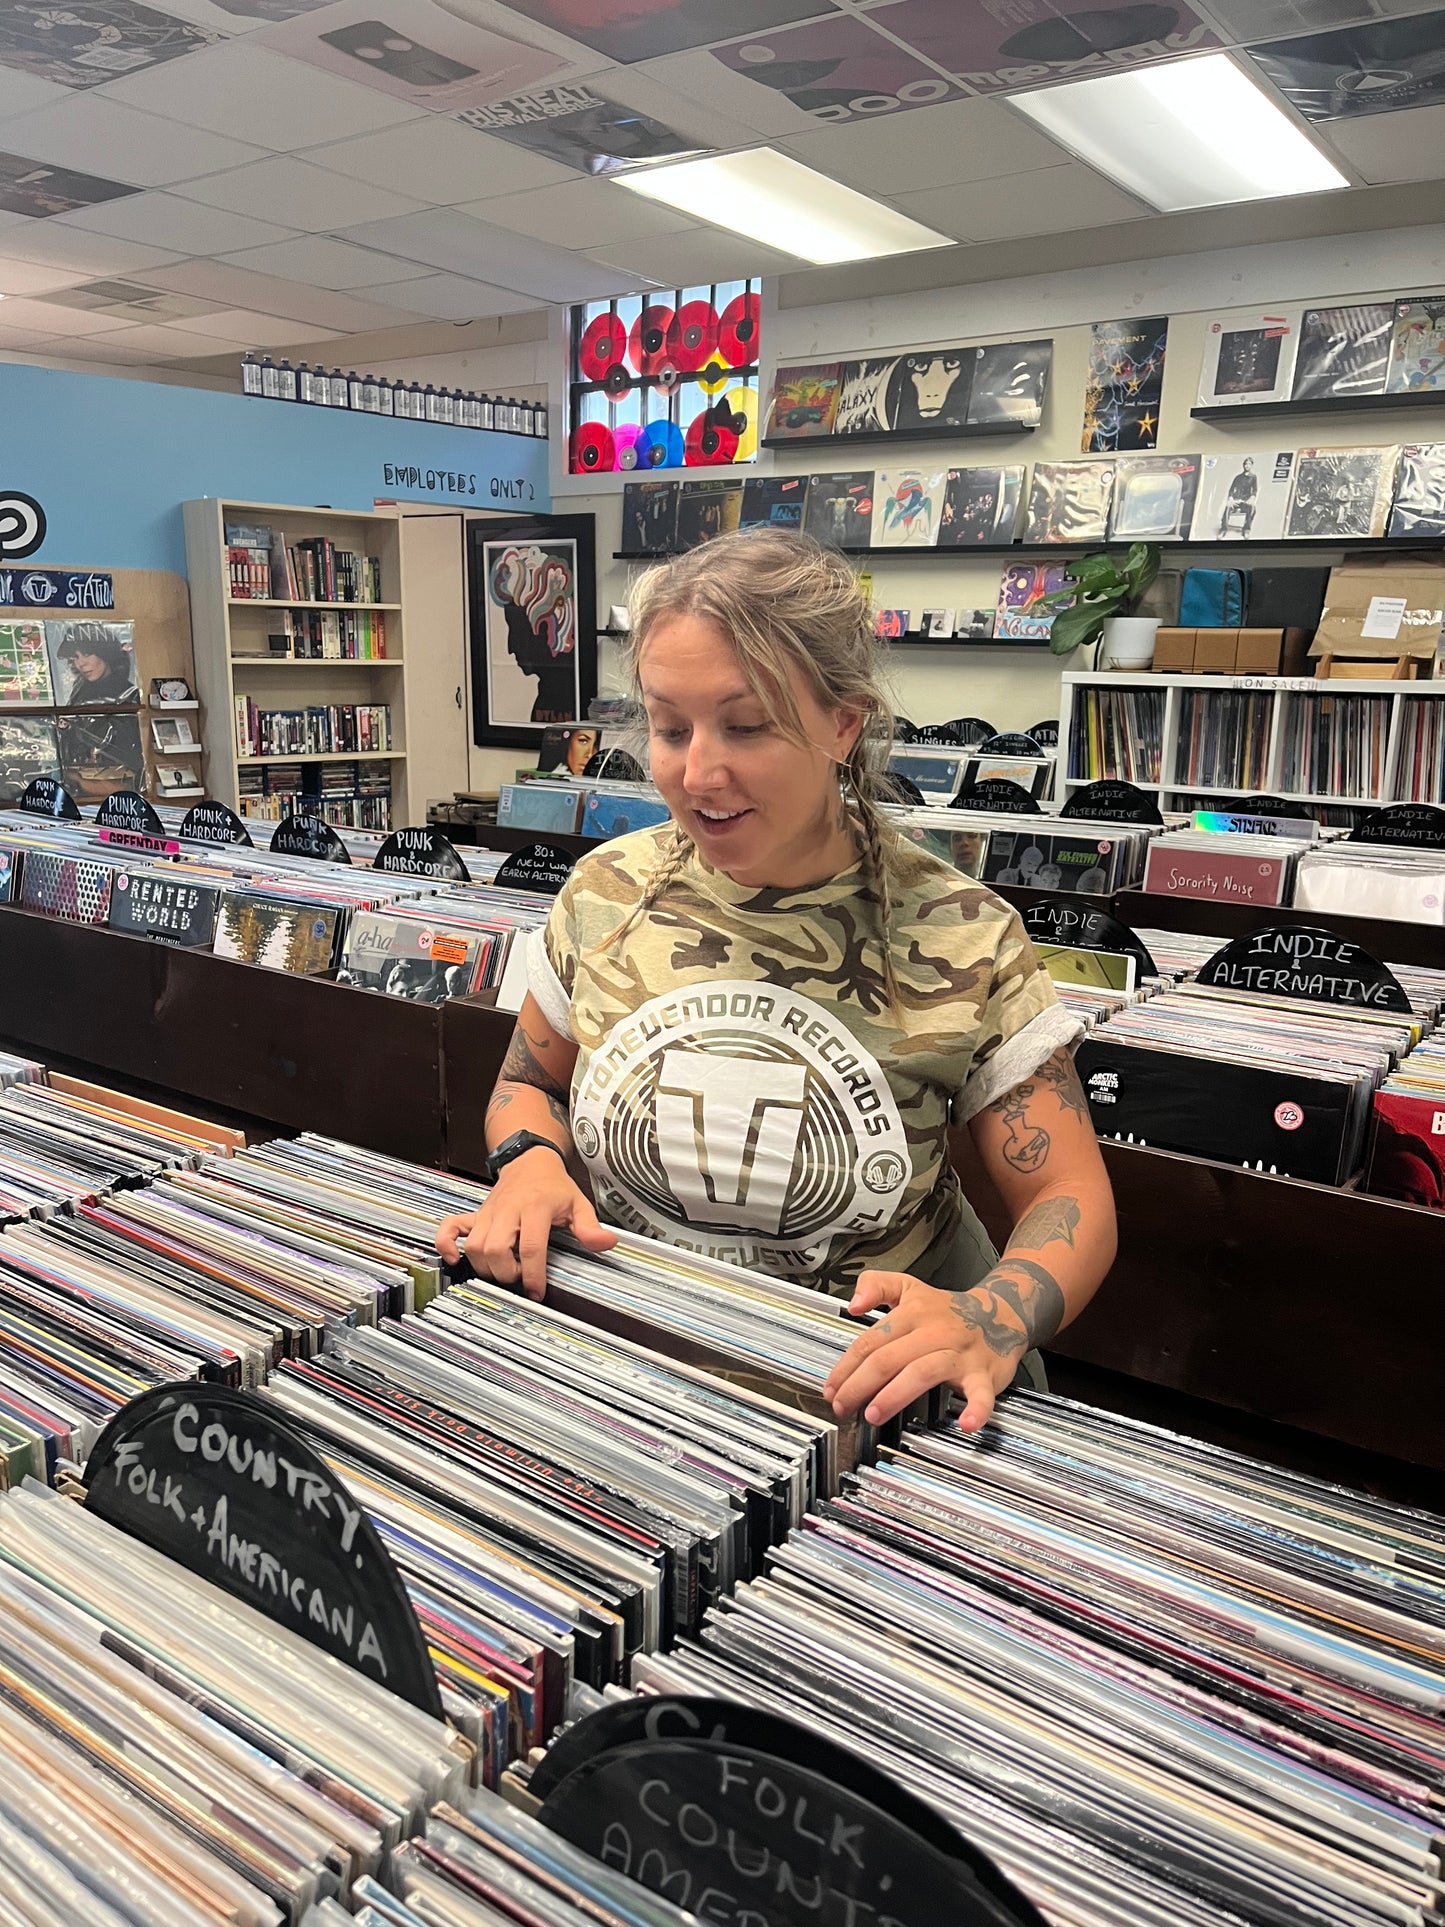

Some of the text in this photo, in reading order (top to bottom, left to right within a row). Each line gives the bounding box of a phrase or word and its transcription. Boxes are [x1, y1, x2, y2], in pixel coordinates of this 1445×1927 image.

[511, 85, 597, 113] HEAT
[544, 98, 606, 118] SERIES
[837, 386, 878, 413] ALAXY
[383, 463, 525, 499] EMPLOYEES ONLY
[911, 734, 957, 746] SINGLES
[35, 780, 56, 792] PUNK
[975, 784, 1014, 796] INDIE
[1088, 789, 1127, 800] INDIE
[25, 794, 64, 812] HARDCORE
[108, 794, 138, 816] PUNK
[955, 798, 1028, 812] ALTERNATIVE
[1068, 806, 1142, 819] ALTERNATIVE
[1245, 798, 1288, 809] INDIE
[101, 812, 149, 831] HARDCORE
[193, 807, 223, 824] PUNK
[292, 815, 327, 836] PUNK
[1386, 809, 1435, 821] INDIE
[109, 831, 168, 852] GREENDAY
[183, 822, 237, 844] HARDCORE
[396, 830, 434, 851] PUNK
[1360, 825, 1445, 841] ALTERNATIV
[277, 833, 345, 860] HARDCORE
[383, 854, 451, 878] HARDCORE
[501, 867, 531, 880] EARLY
[517, 858, 545, 869] NEW
[129, 878, 199, 910] RENTED
[1167, 868, 1254, 899] Sorority Noise
[131, 901, 191, 931] WORLD
[1027, 906, 1102, 931] INDIE
[357, 926, 394, 951] a-ha
[1055, 926, 1063, 936] &
[1248, 932, 1361, 965] INDIE
[1292, 958, 1302, 971] &
[1213, 961, 1399, 1006] ALTERNATIVE
[780, 1005, 891, 1138] RECORDS
[1091, 1072, 1119, 1081] ARCTIC
[1087, 1078, 1119, 1089] MONKEYS
[425, 1407, 468, 1433] Dark
[113, 1441, 187, 1524] FOLK
[207, 1494, 387, 1679] AMERICANA
